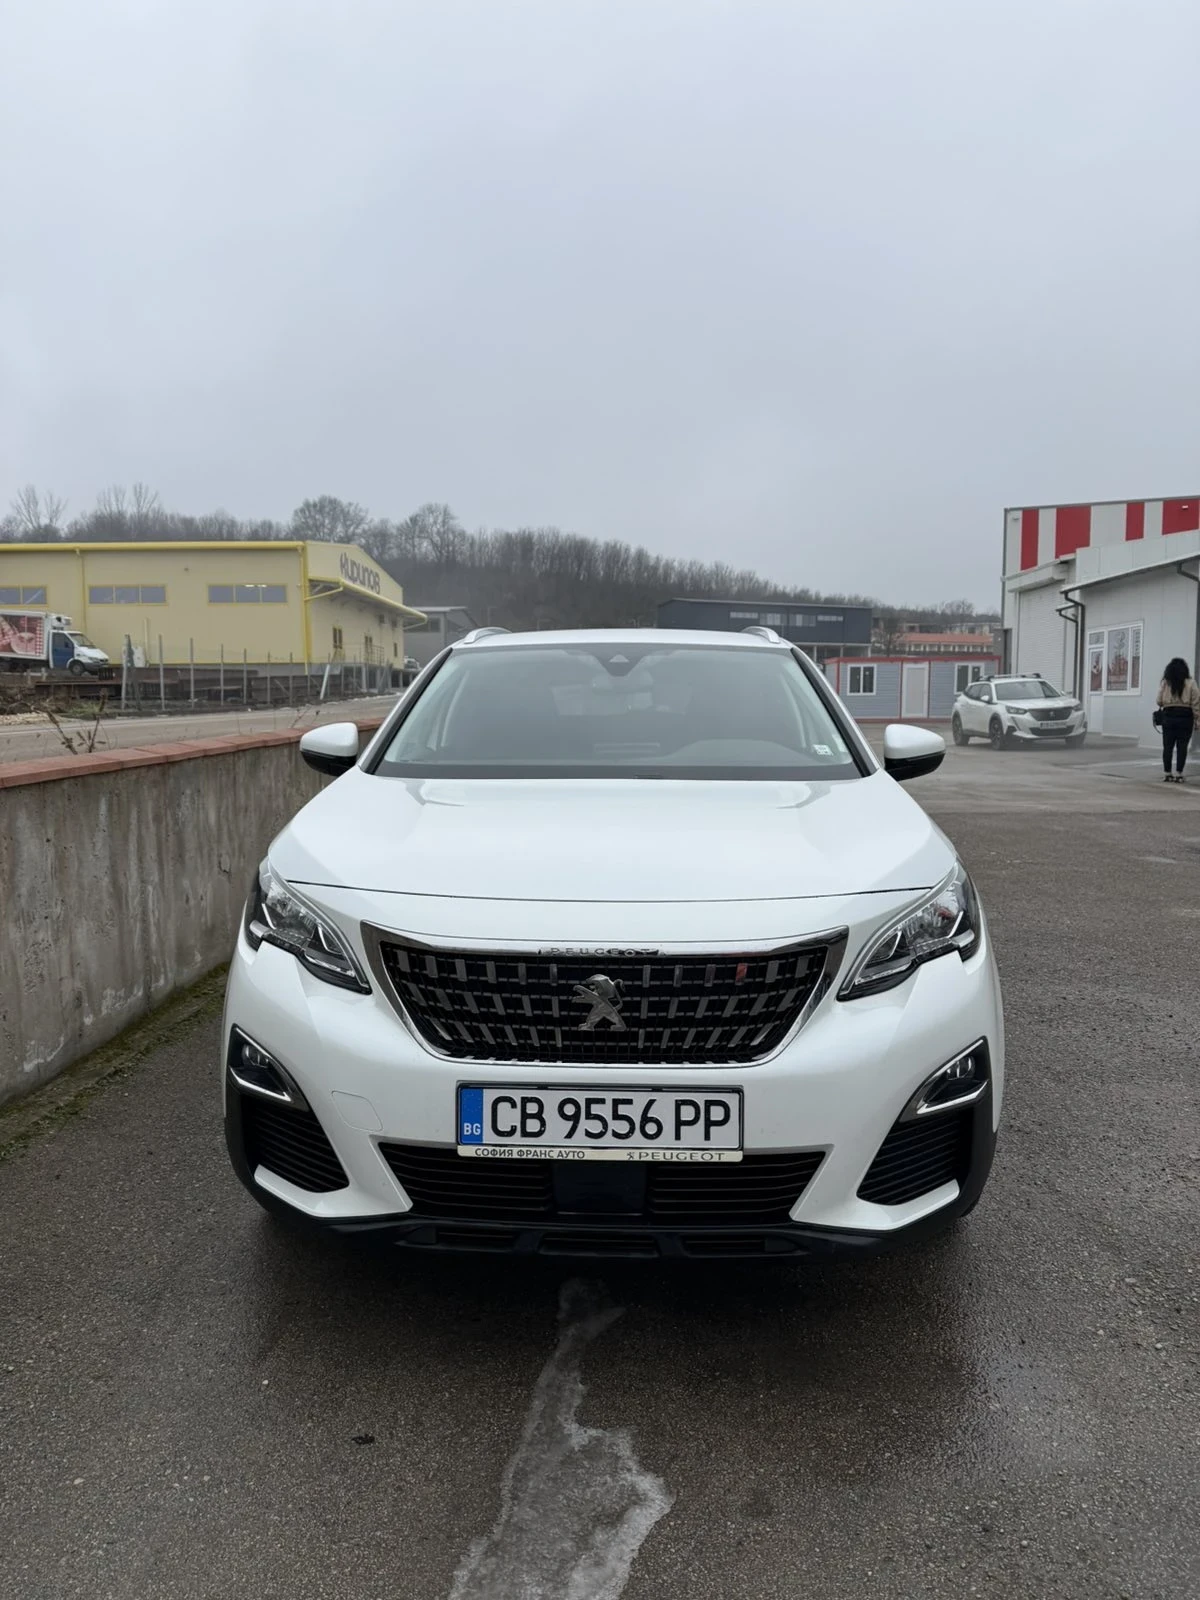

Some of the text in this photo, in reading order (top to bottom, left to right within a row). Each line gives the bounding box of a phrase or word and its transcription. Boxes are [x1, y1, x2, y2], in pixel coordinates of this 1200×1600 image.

[550, 947, 650, 958] PEUGEOT
[490, 1095, 731, 1141] CB 9556 PP
[463, 1122, 481, 1136] BG
[475, 1147, 586, 1159] СОФИЯ ФРАНС АУТО
[638, 1151, 725, 1161] PEUGEOT
